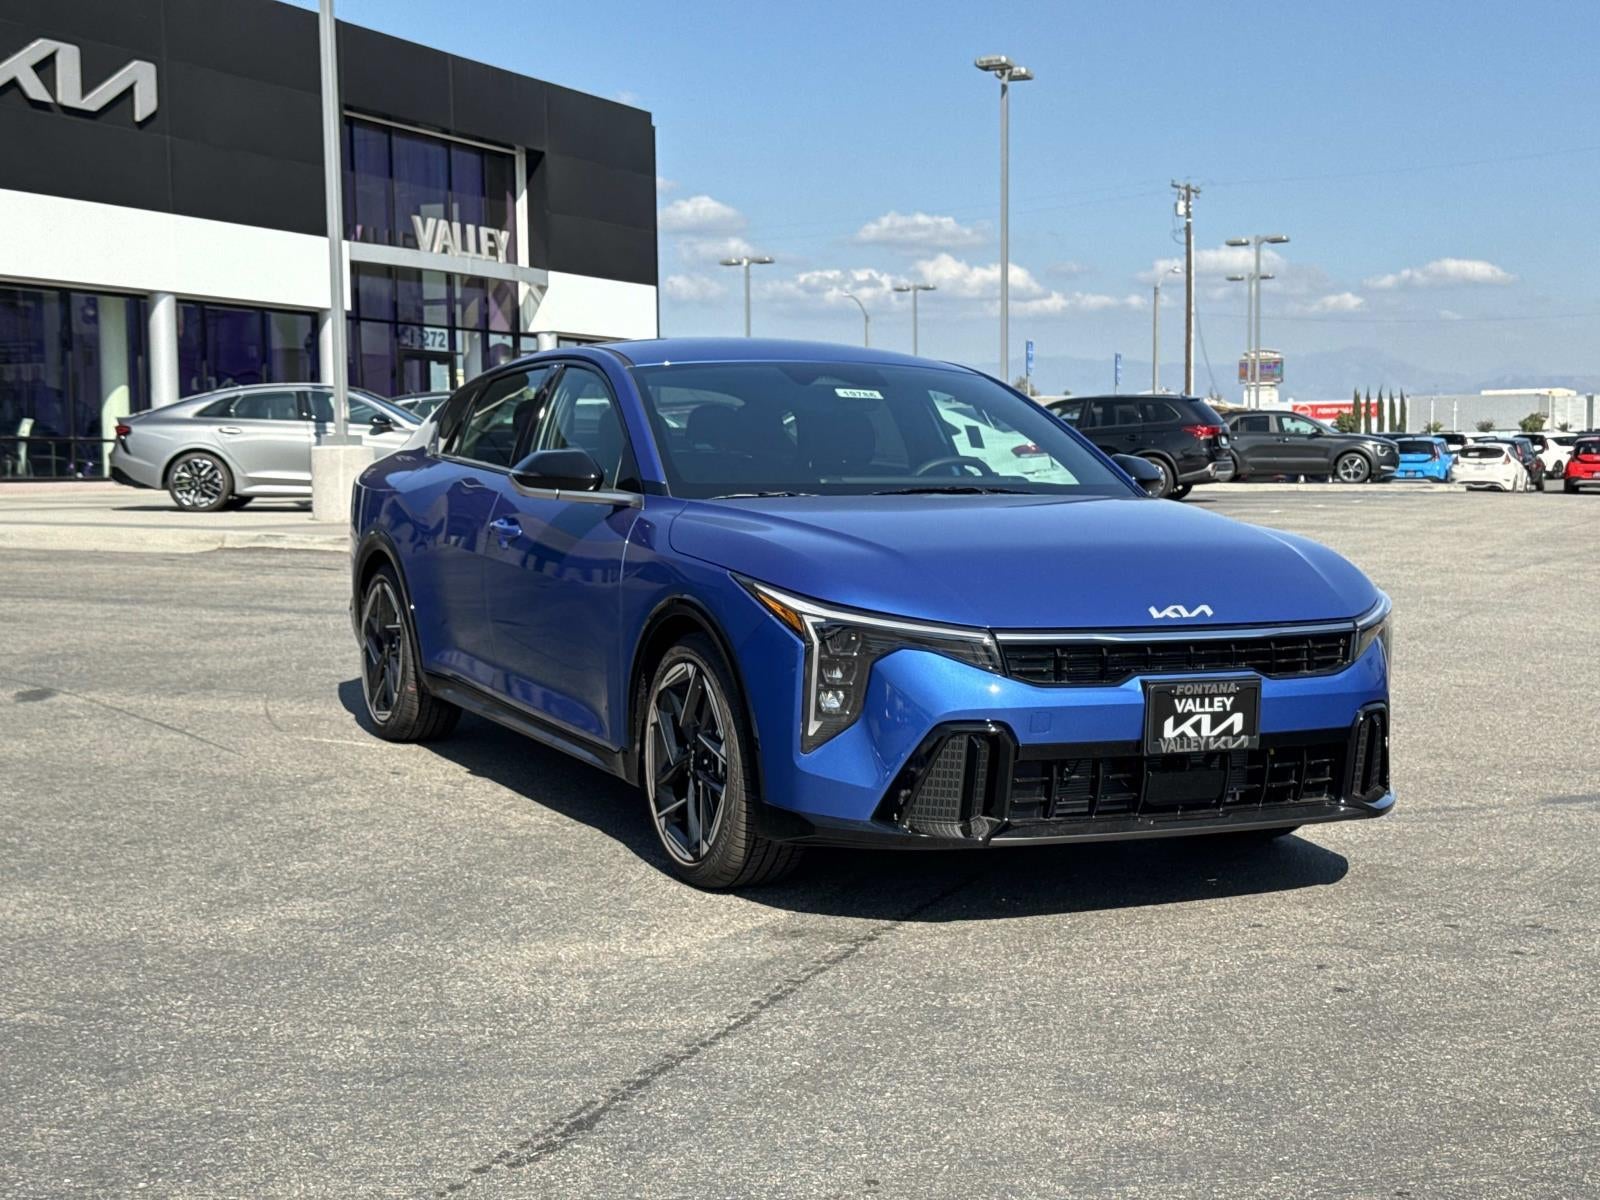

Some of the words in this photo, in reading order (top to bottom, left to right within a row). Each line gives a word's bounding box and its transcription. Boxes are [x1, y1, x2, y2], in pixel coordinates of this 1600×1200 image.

[411, 214, 510, 264] VALLEY
[1148, 605, 1214, 619] KIA
[1176, 683, 1237, 695] FONTANA
[1174, 696, 1235, 713] VALLEY
[1163, 712, 1244, 738] KIA
[1159, 735, 1208, 753] VALLEY
[1209, 735, 1249, 750] KIA
